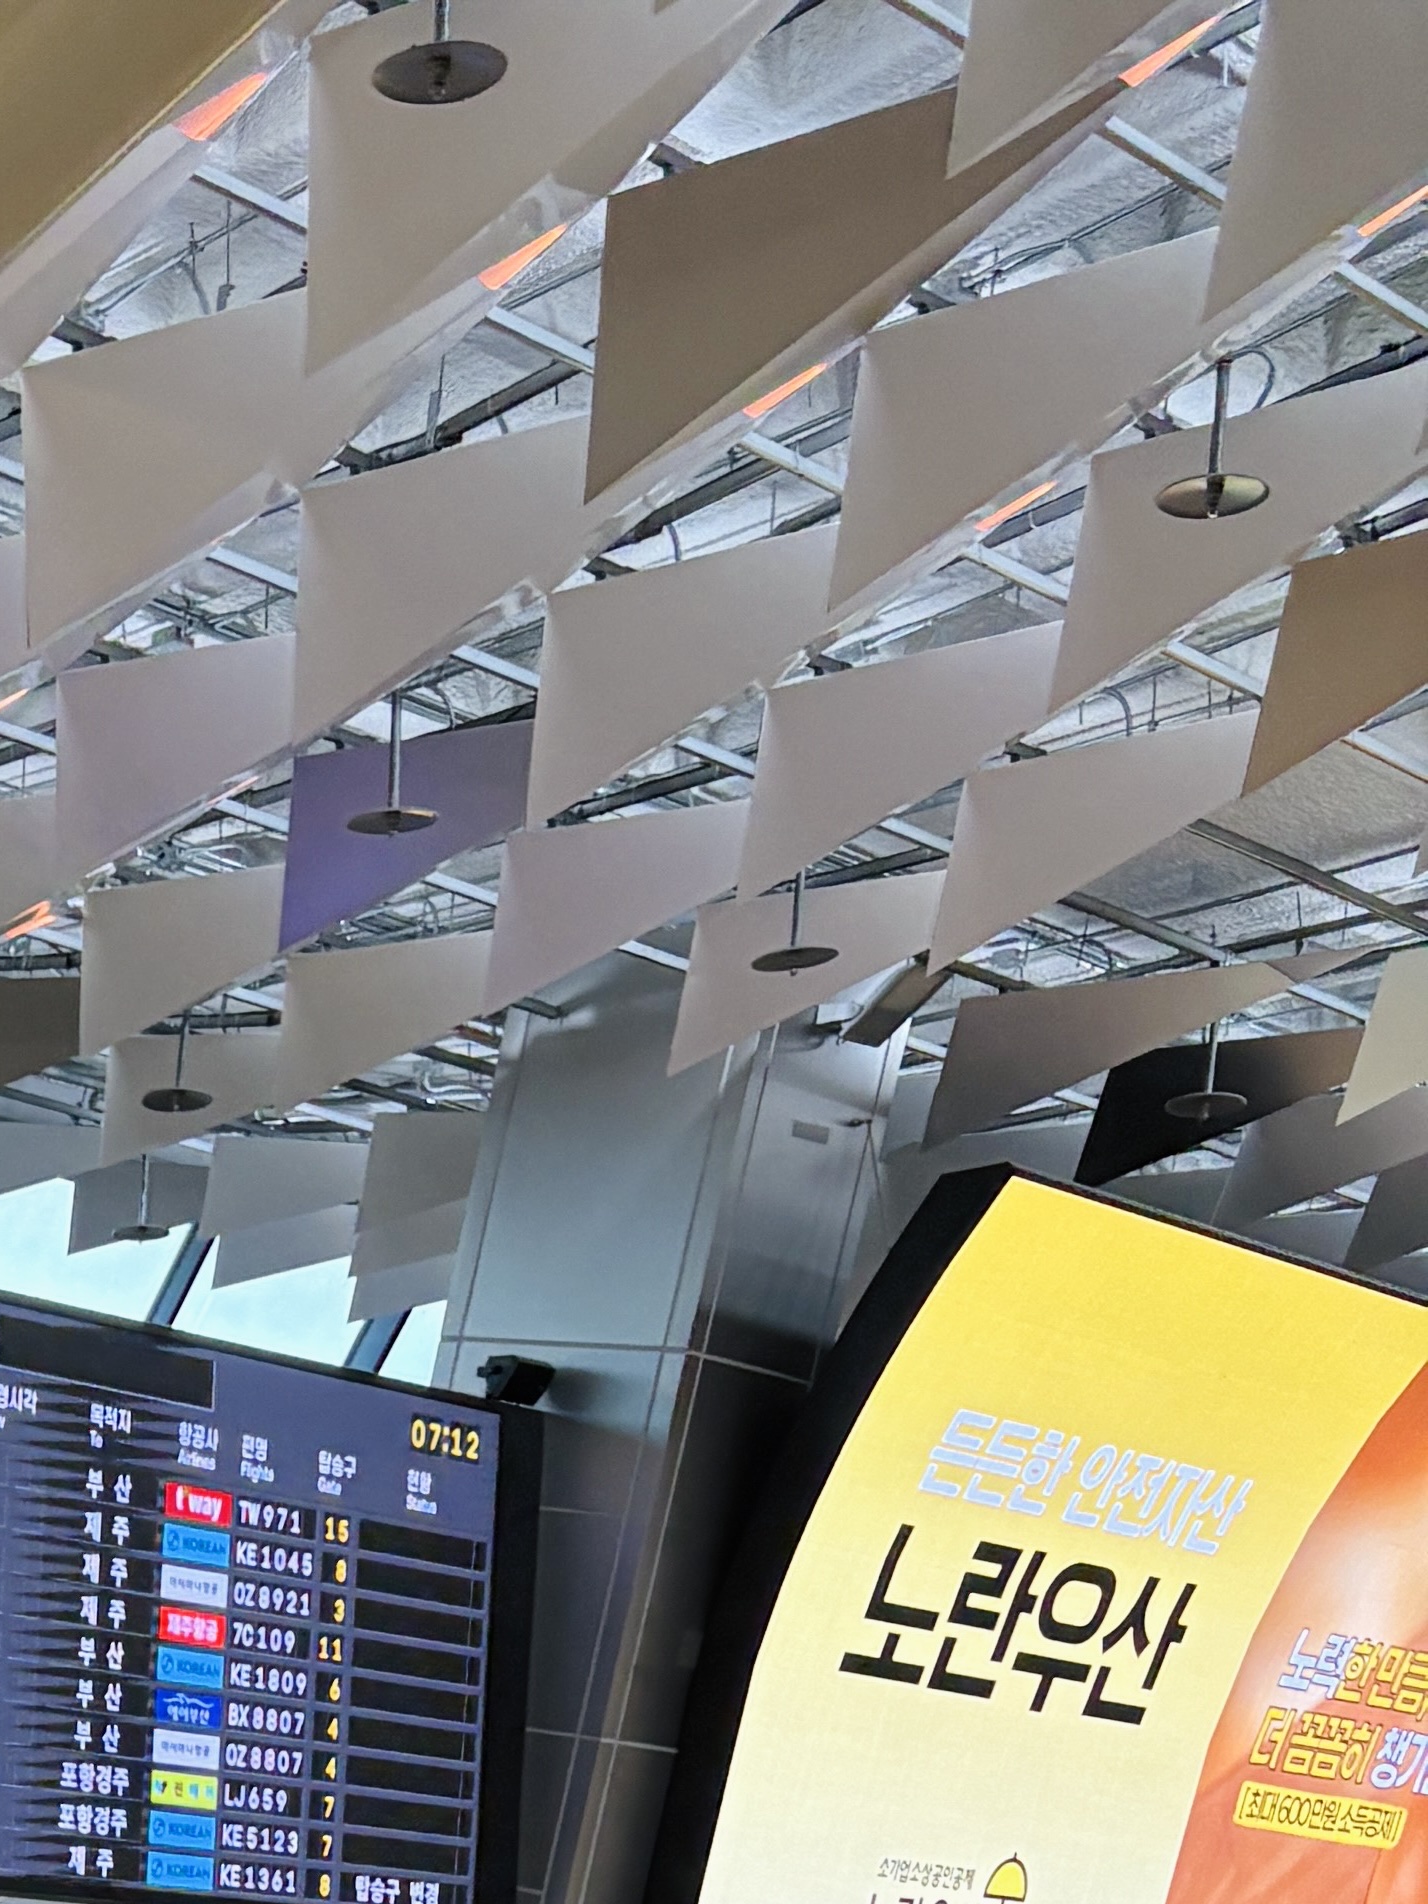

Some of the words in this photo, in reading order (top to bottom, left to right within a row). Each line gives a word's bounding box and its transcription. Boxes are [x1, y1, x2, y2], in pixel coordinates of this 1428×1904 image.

[410, 1419, 481, 1460] 07:12
[917, 1408, 1081, 1516] 든든한
[1061, 1444, 1254, 1555] 안전자산
[238, 1500, 301, 1534] TW971
[325, 1516, 349, 1543] 15
[236, 1540, 313, 1577] KE1045
[335, 1559, 347, 1584] 8
[334, 1599, 345, 1623] 3
[839, 1523, 1197, 1725] 노란우산
[232, 1622, 296, 1652] 7C109
[319, 1637, 342, 1662] 11
[229, 1663, 307, 1696] KE1809
[329, 1678, 341, 1702] 6
[1278, 1627, 1384, 1704] 노력한
[227, 1703, 304, 1735] BX8807
[327, 1718, 338, 1741] 4
[1249, 1706, 1297, 1769] 더
[1282, 1711, 1383, 1785] 꼼꼼히
[60, 1762, 129, 1797] 포항경주
[224, 1783, 287, 1812] LJ659
[324, 1796, 334, 1818] 7
[325, 1757, 336, 1780] 4
[58, 1803, 127, 1838] 포항경주
[222, 1824, 298, 1855] KE5123
[322, 1835, 332, 1857] 7
[219, 1864, 295, 1894] KE1361
[319, 1874, 331, 1898] 8
